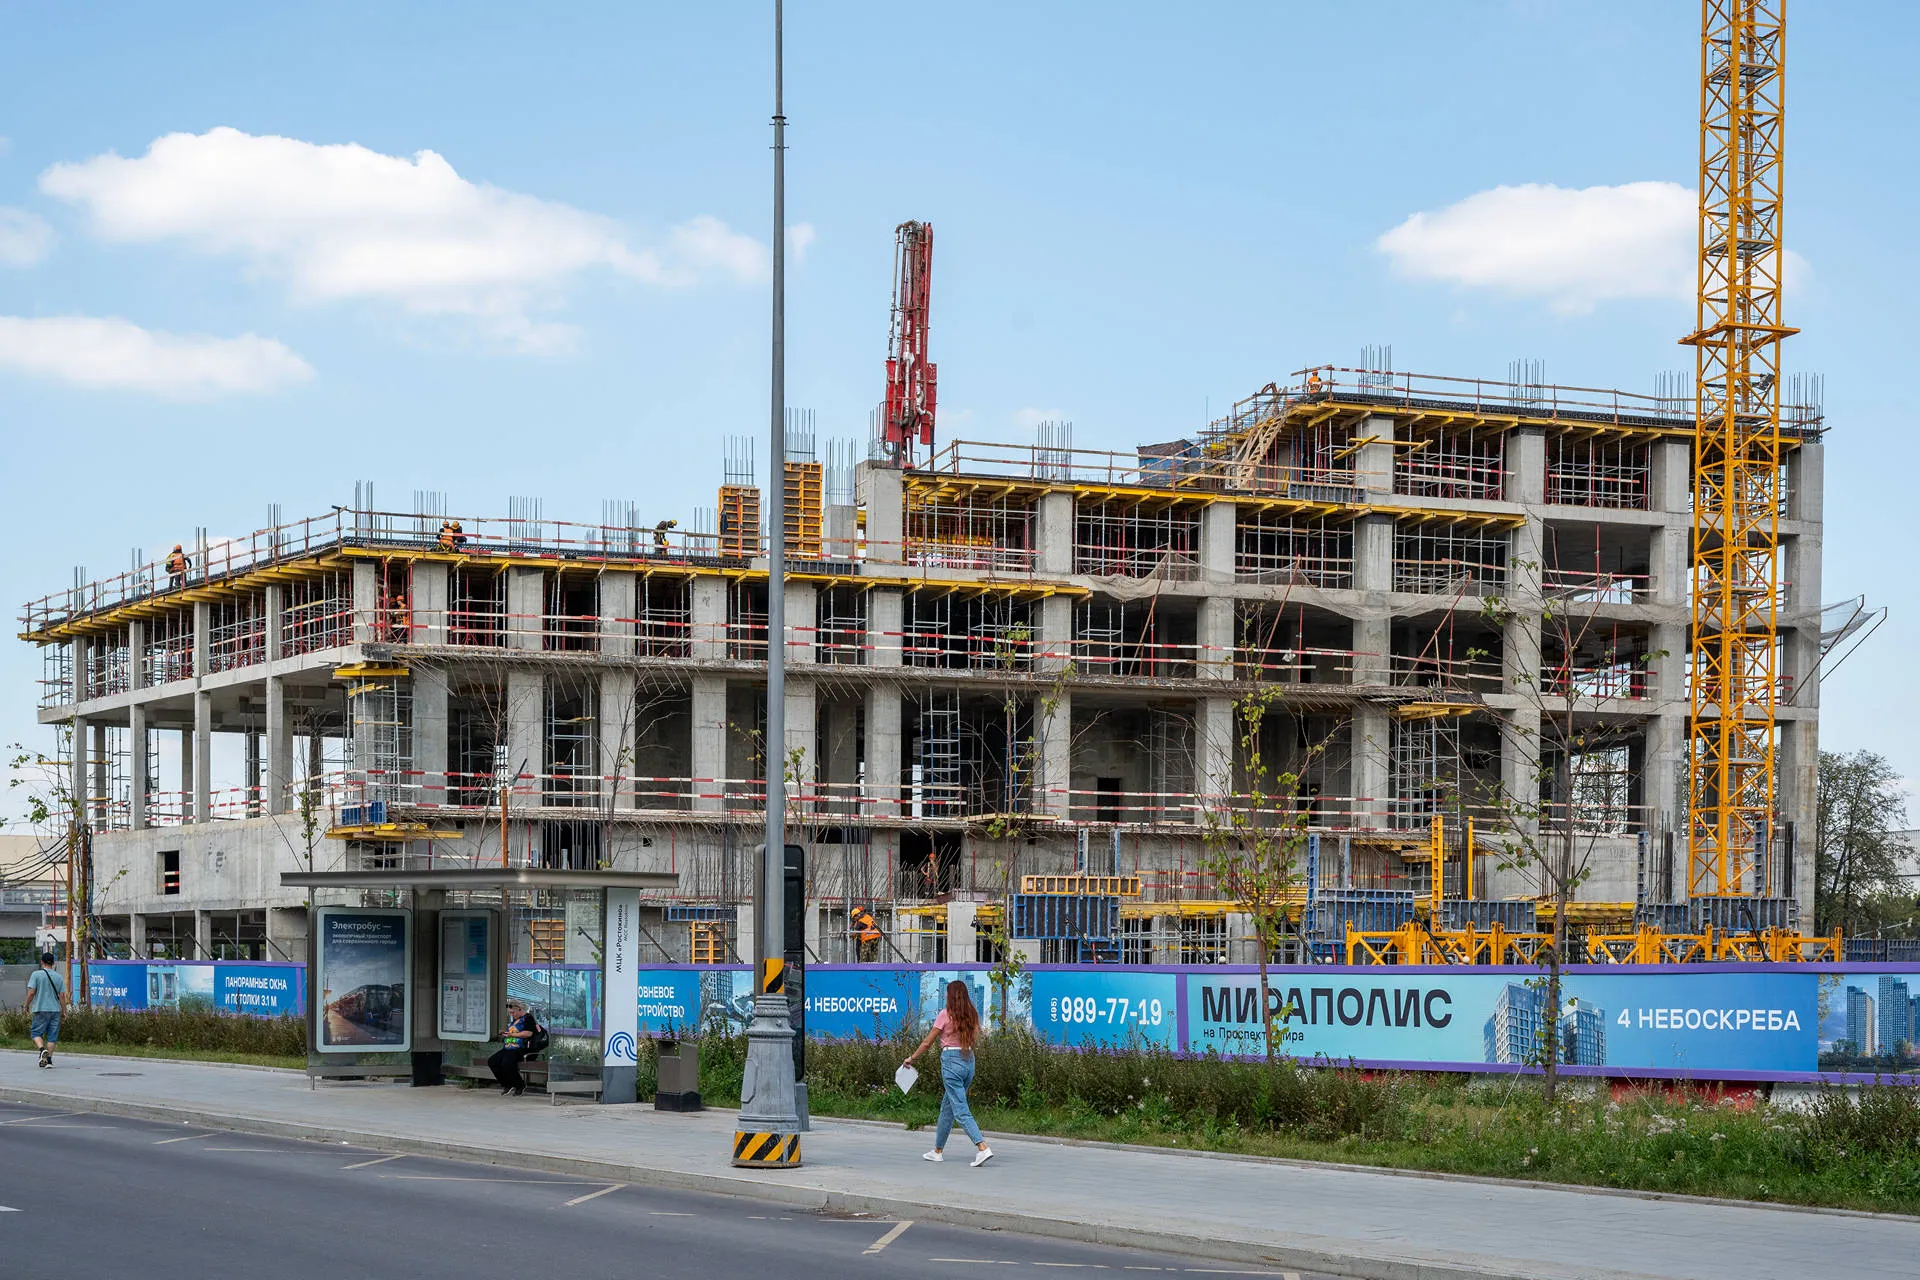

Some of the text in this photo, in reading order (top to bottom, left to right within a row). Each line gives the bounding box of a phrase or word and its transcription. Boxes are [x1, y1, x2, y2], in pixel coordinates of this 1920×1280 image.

[332, 921, 381, 931] Электробус
[225, 976, 288, 990] ПАНОРАМНЫЕ ОКНА
[225, 993, 230, 1005] И
[804, 997, 898, 1013] 4 НЕБОСКРЕБА
[1050, 996, 1162, 1026] (495) 989-77-19
[1202, 986, 1453, 1029] МИРАПОЛИС
[1617, 1008, 1801, 1031] 4 НЕБОСКРЕБА
[1203, 1027, 1304, 1043] на Проспект ира
